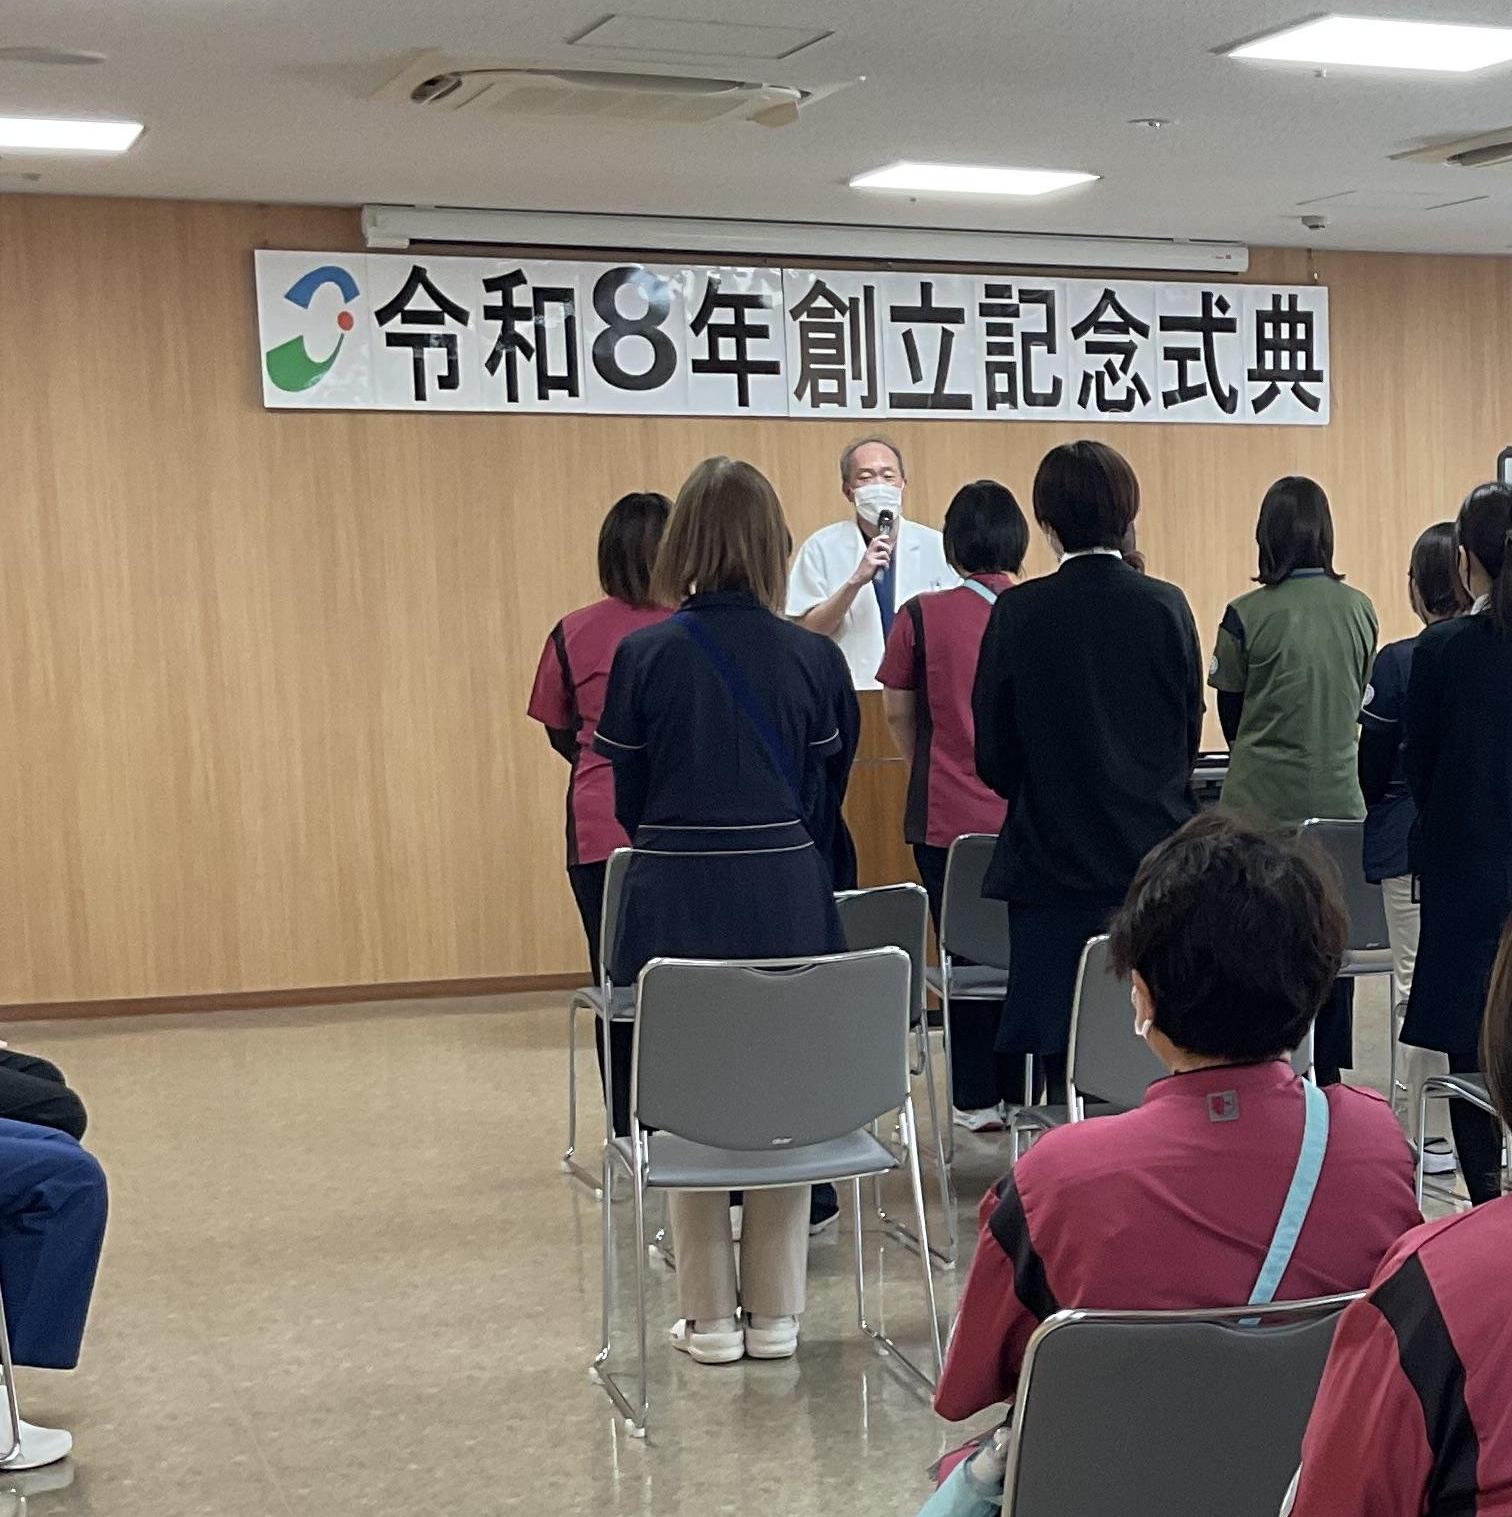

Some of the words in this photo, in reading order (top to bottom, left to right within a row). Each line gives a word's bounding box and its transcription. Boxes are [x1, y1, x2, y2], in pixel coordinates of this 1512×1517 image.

[373, 263, 1325, 416] 令和8年創立記念式典
